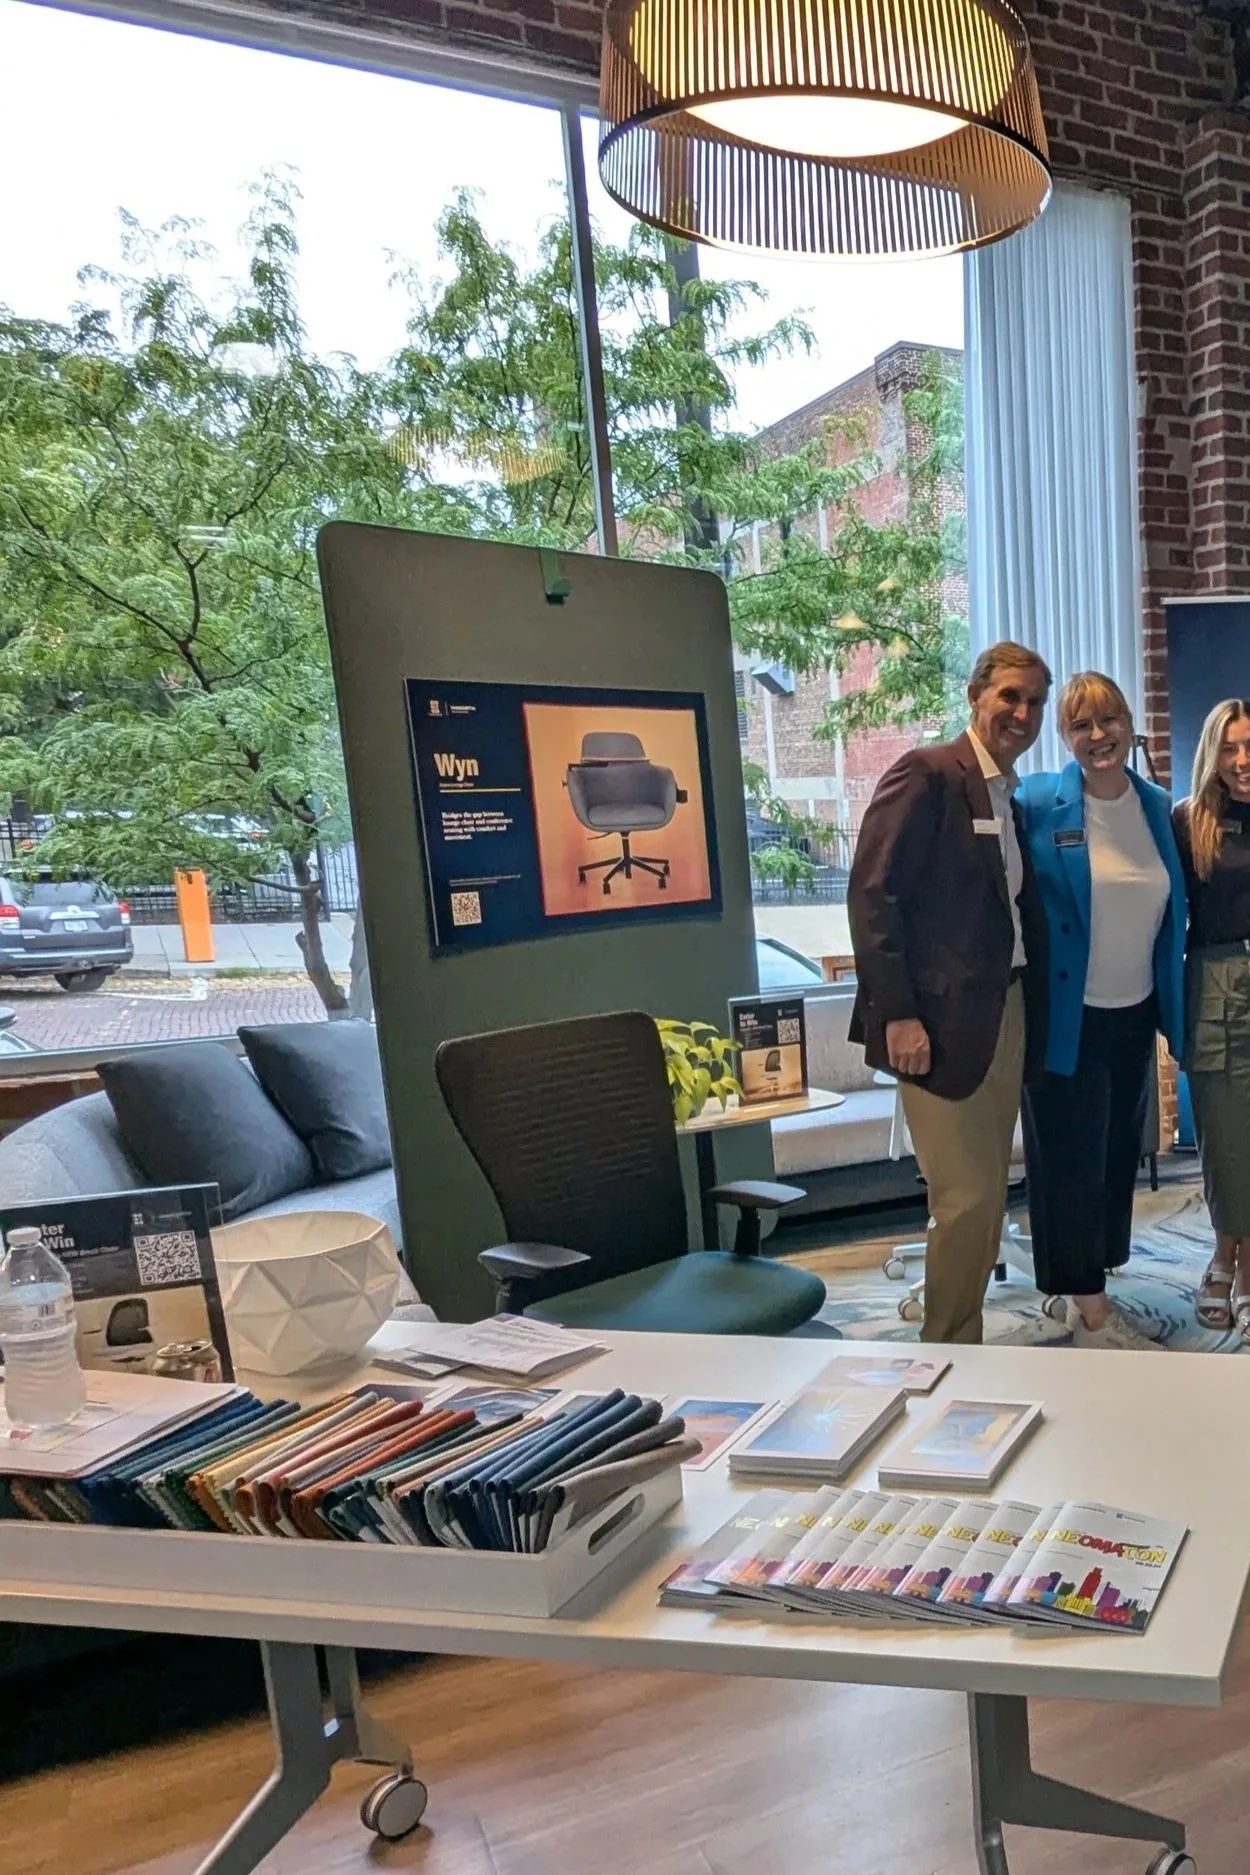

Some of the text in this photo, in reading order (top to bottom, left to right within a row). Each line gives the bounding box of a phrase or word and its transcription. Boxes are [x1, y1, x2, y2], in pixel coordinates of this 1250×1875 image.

[433, 753, 479, 782] Wyn
[41, 1224, 65, 1236] ter
[43, 1236, 75, 1250] Win
